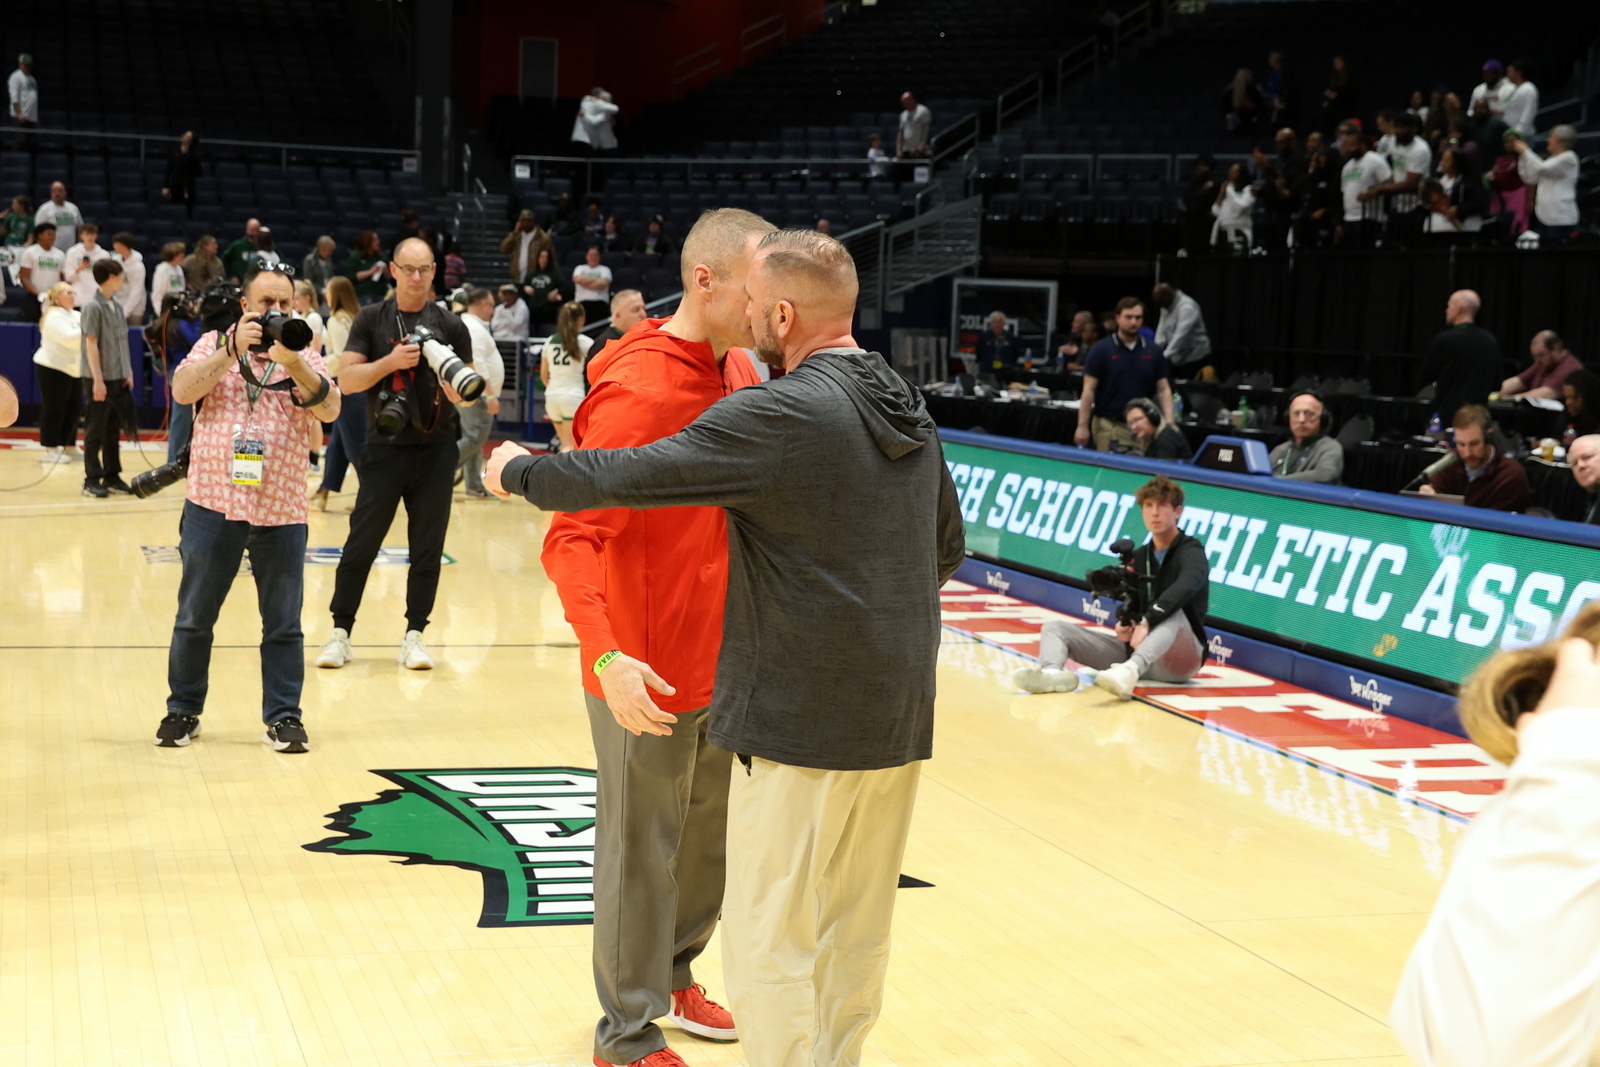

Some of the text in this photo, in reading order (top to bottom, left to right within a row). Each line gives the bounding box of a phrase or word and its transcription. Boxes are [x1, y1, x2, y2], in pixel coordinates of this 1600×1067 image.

[553, 347, 570, 365] 22
[945, 461, 996, 523] GH
[986, 472, 1136, 558] SCHOOL
[1143, 505, 1408, 622] THLETIC
[1208, 635, 1233, 665] Kroger
[1361, 678, 1393, 712] Kroger
